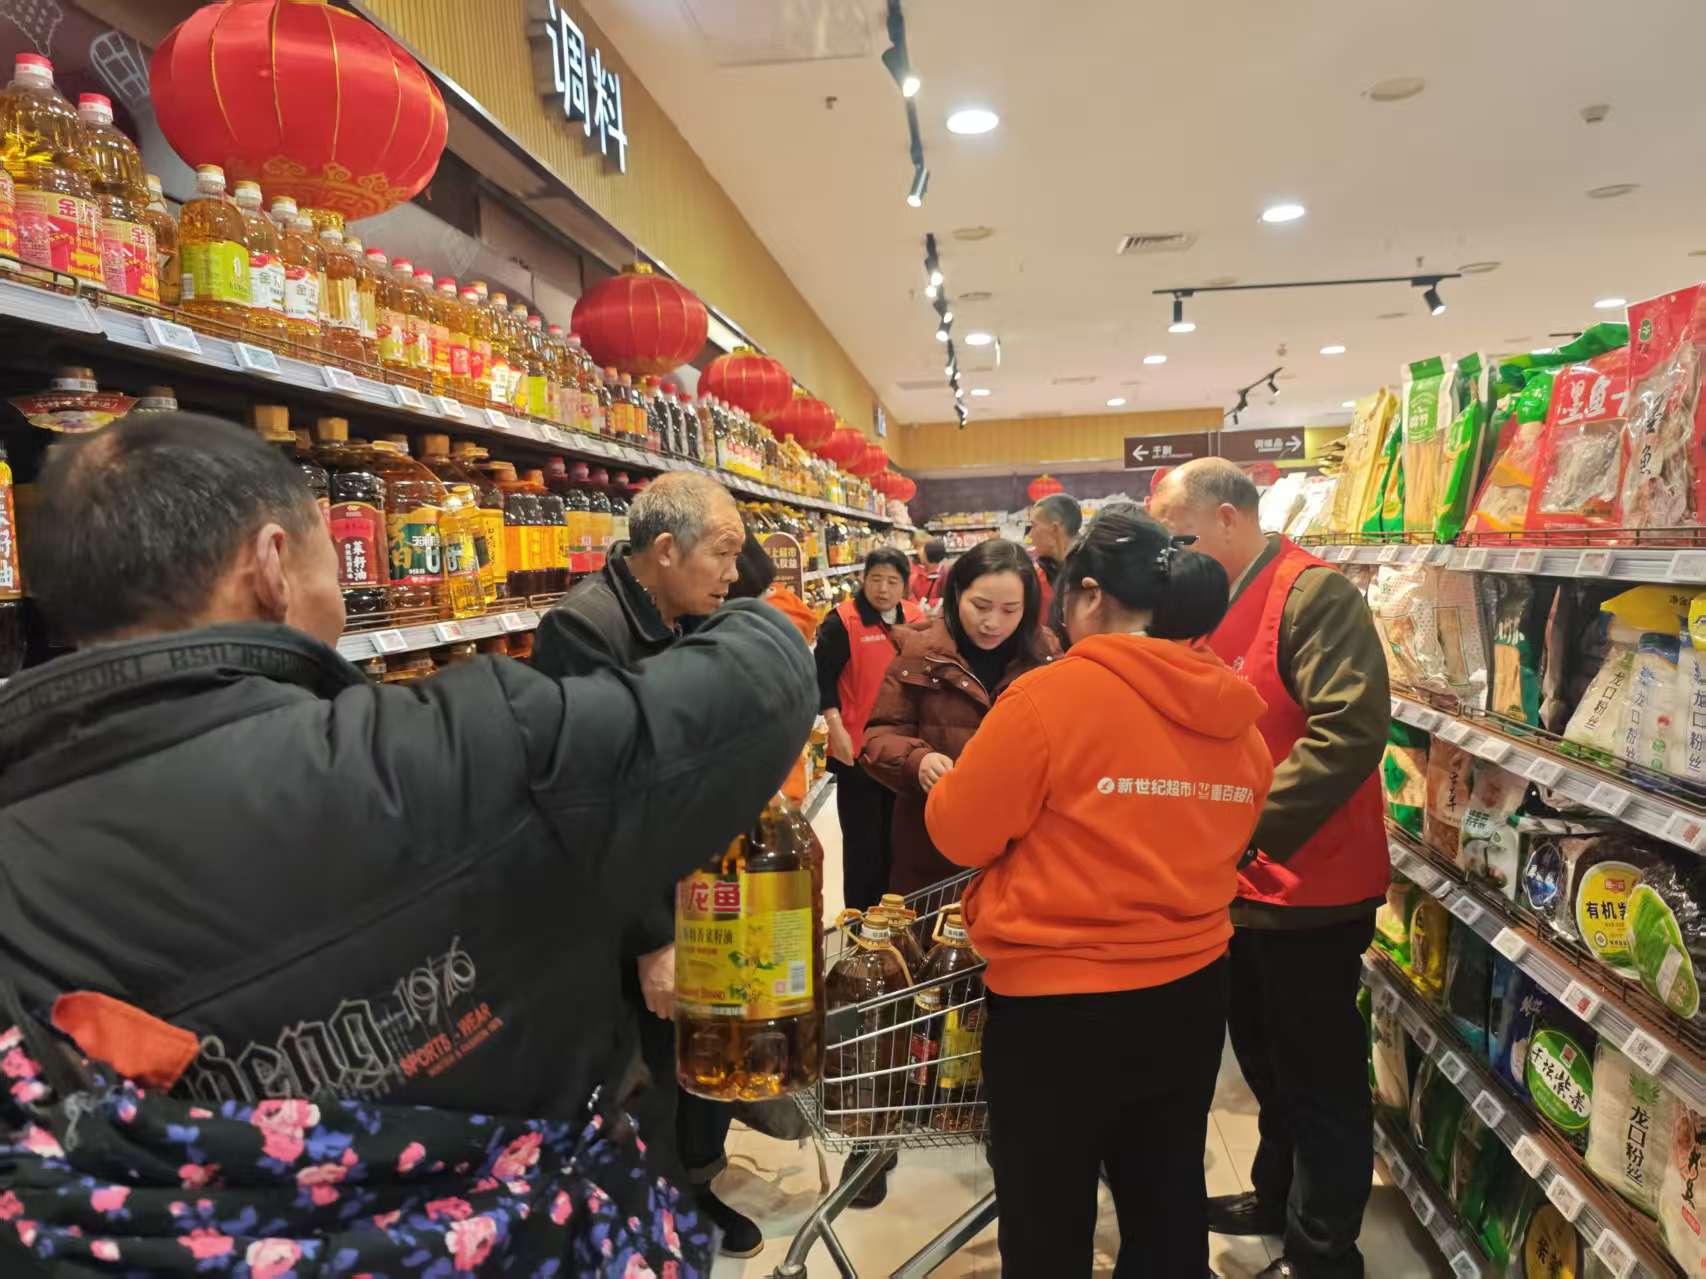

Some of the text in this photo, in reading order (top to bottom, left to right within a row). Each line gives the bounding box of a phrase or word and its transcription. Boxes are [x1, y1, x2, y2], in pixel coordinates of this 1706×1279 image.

[545, 0, 628, 174] 调料
[1117, 777, 1193, 798] 新世纪超市
[1625, 1104, 1651, 1188] 龙口粉丝
